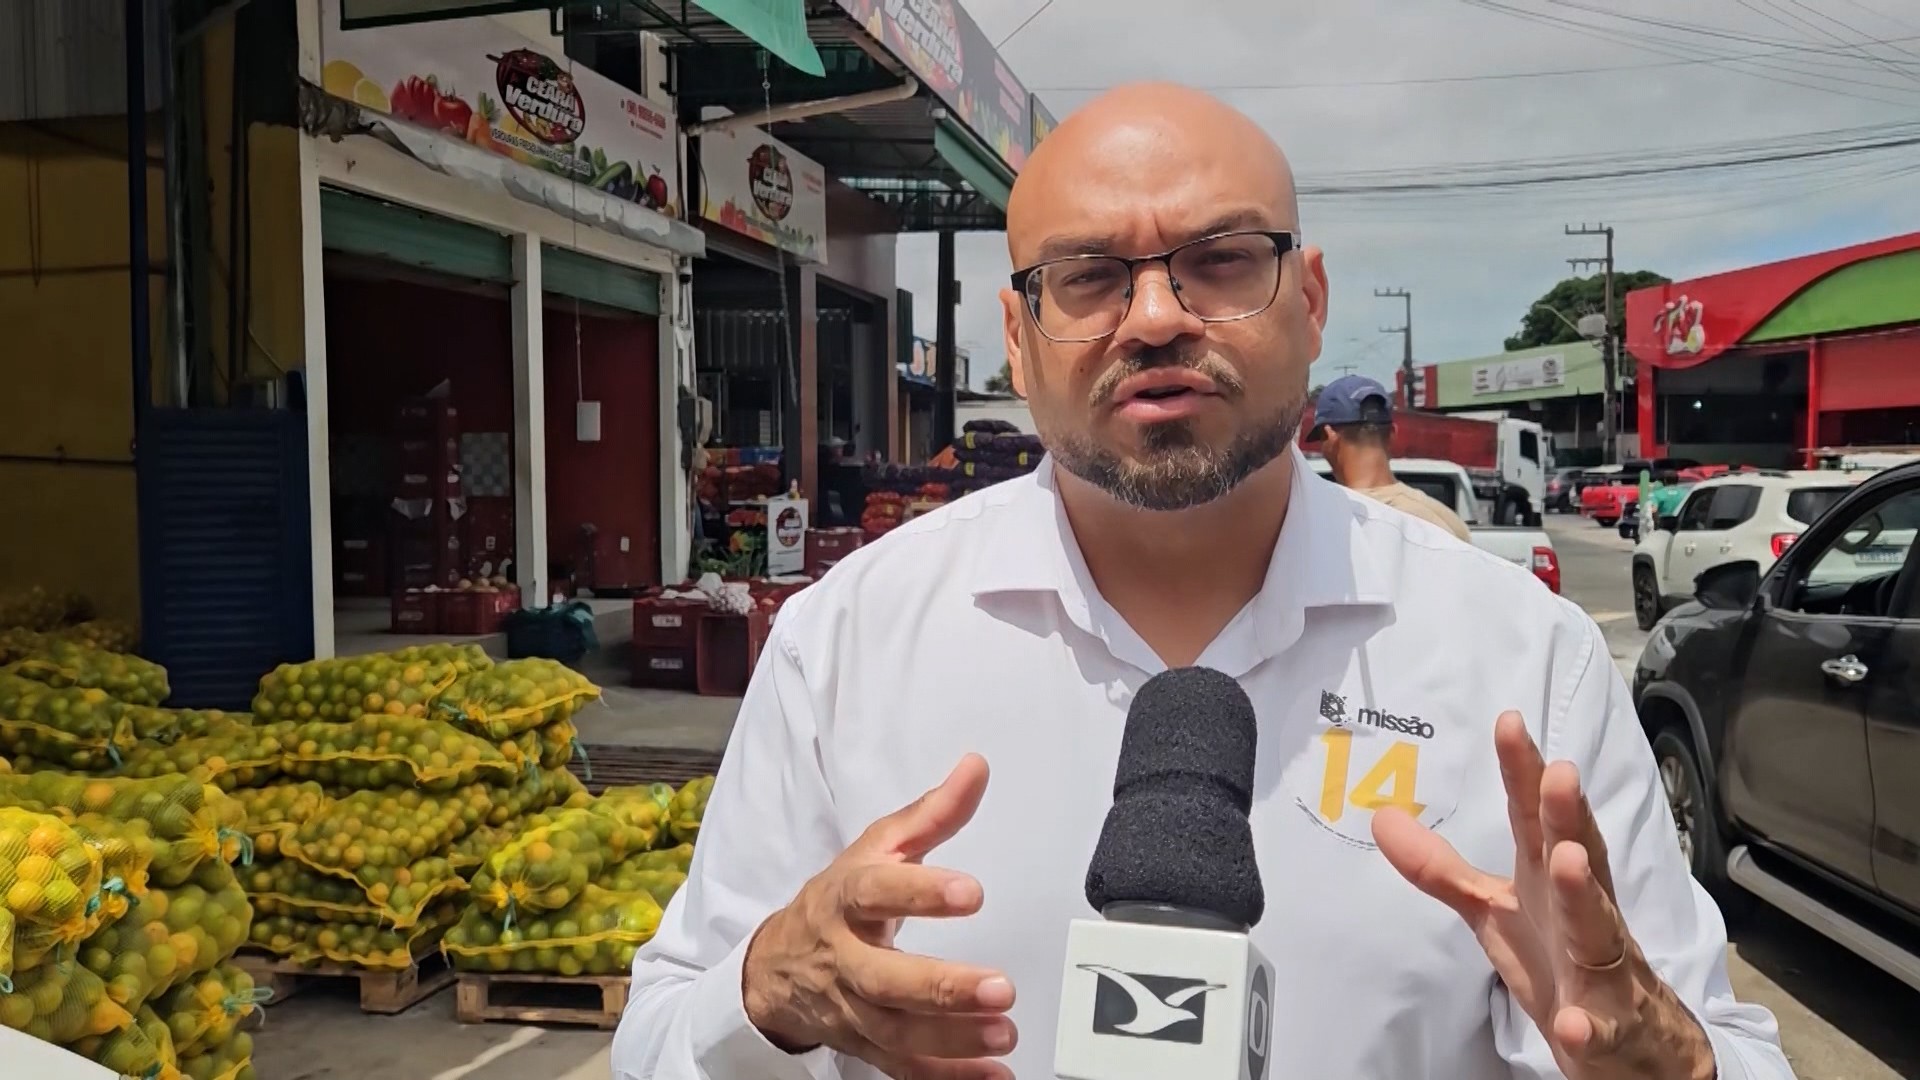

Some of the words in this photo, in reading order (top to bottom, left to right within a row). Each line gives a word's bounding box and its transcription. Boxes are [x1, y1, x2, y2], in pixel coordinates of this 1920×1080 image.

[505, 84, 583, 133] Verdura
[1358, 706, 1435, 739] missão
[1319, 726, 1427, 824] 14
